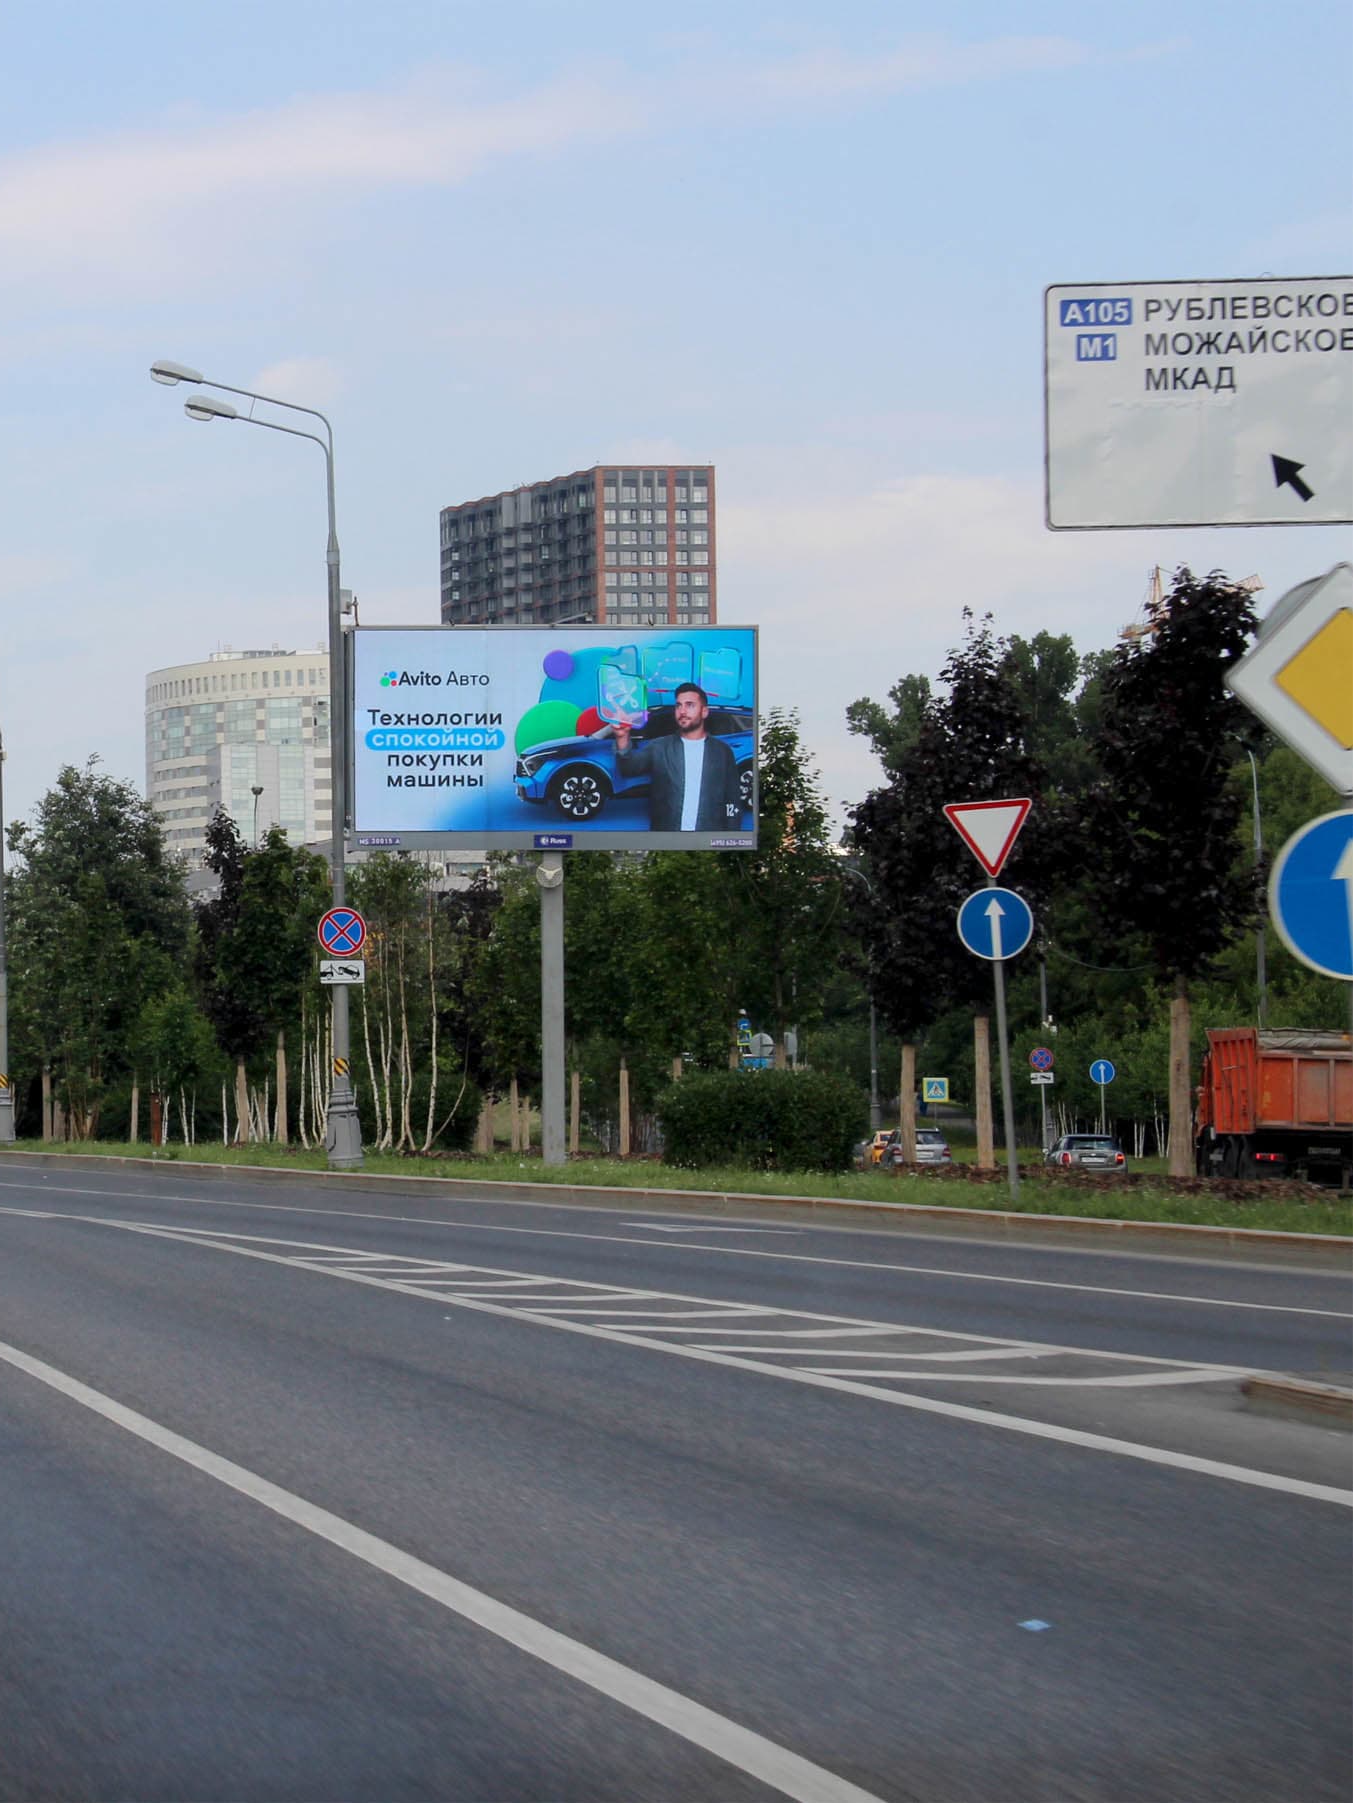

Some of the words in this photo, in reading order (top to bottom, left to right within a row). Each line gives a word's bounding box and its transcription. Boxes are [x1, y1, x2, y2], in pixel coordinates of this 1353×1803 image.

[1144, 326, 1353, 356] МОЖАЙСКОЕ
[1144, 366, 1237, 393] МКАД
[398, 671, 442, 686] Avito
[446, 671, 490, 686] Авто
[367, 709, 503, 726] Технологии
[371, 728, 499, 747] спокойной
[387, 754, 484, 771] покупки
[386, 775, 484, 787] машины
[726, 803, 739, 817] 12+
